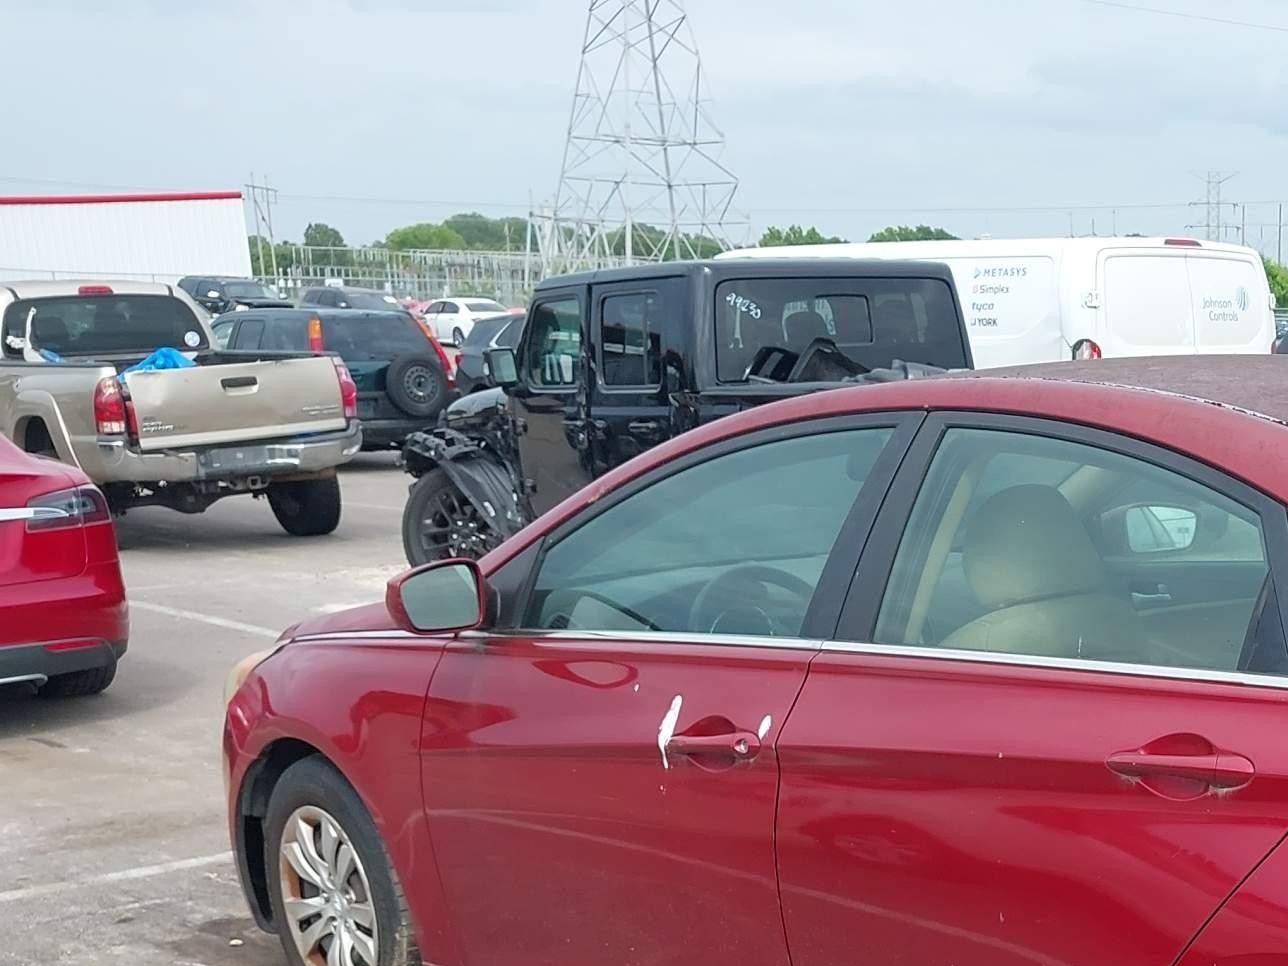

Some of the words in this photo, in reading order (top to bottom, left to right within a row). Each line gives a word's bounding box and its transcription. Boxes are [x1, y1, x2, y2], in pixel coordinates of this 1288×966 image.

[983, 267, 1027, 277] METASYS
[1202, 296, 1233, 309] Johnson
[1208, 310, 1239, 321] Controls
